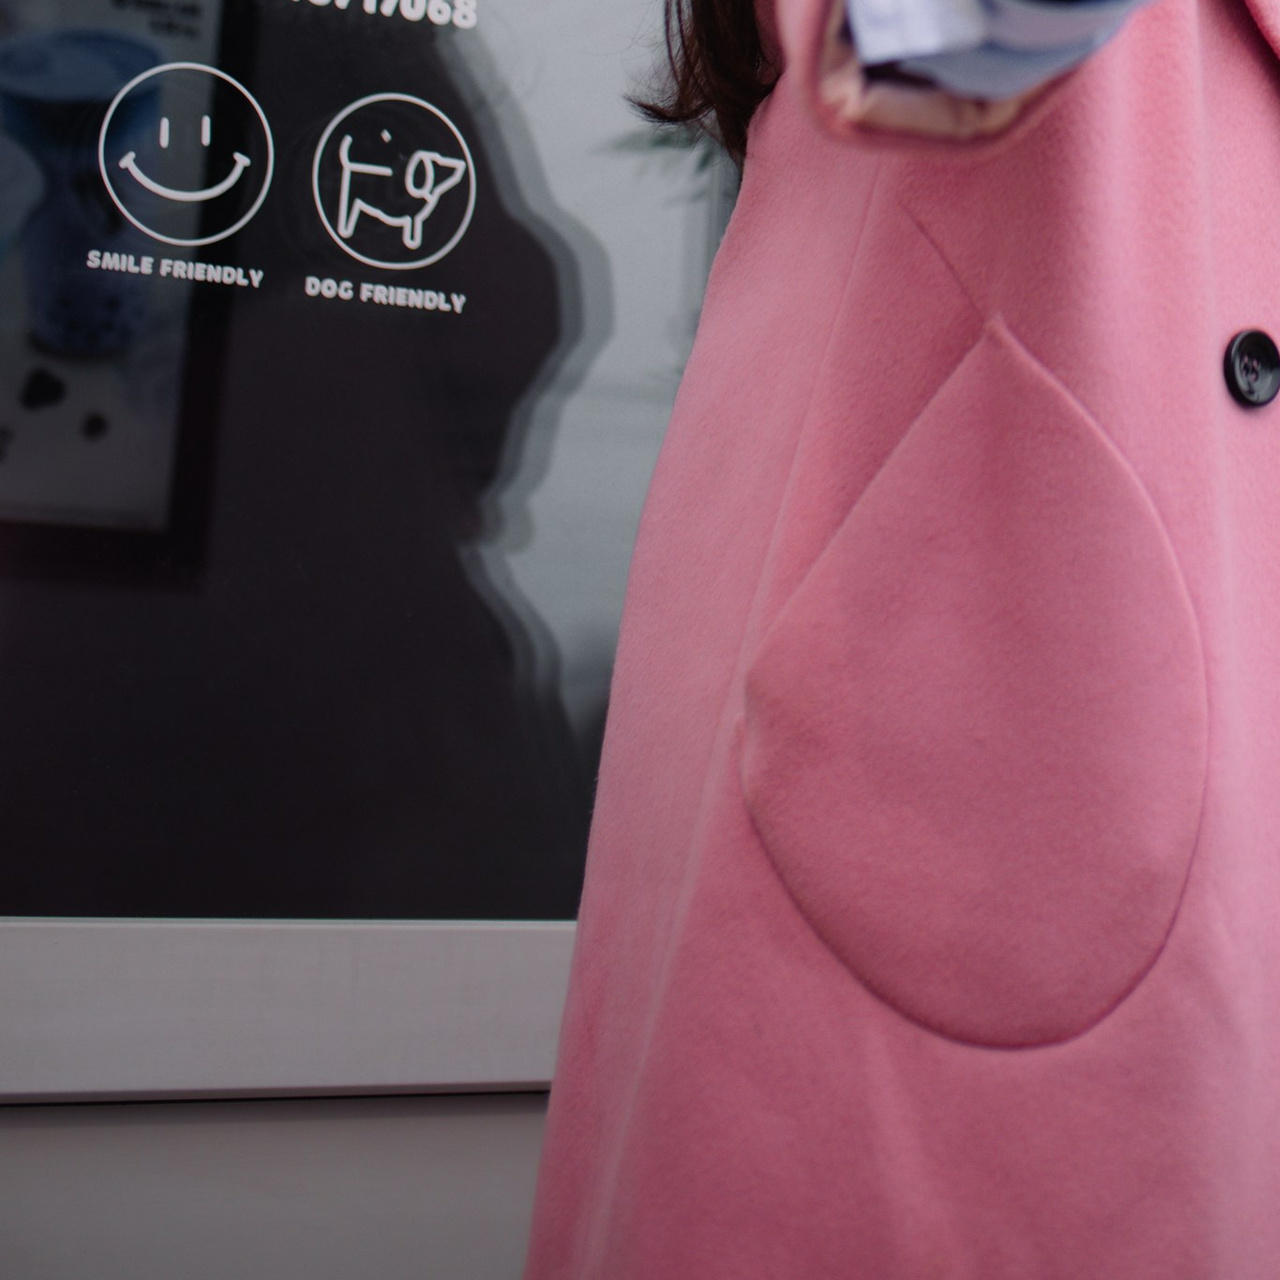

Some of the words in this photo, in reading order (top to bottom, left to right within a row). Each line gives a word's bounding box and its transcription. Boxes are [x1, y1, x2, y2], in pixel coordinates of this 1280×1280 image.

[86, 250, 154, 275] SMILE
[159, 258, 264, 289] FRIENDLY
[305, 275, 354, 301] DOG
[359, 282, 467, 314] FRIENDLY
